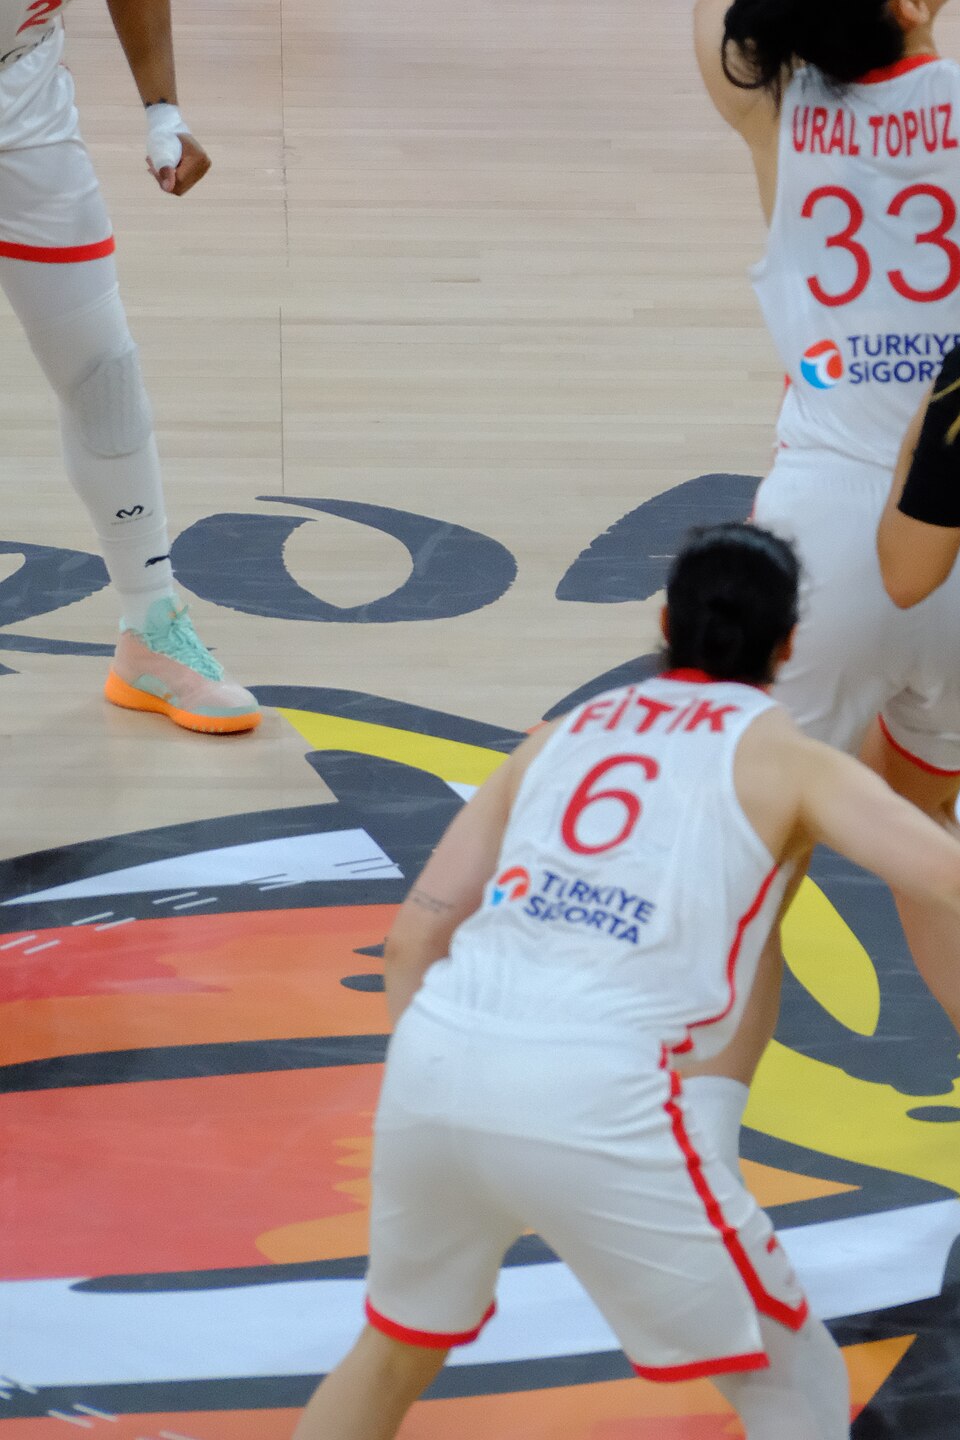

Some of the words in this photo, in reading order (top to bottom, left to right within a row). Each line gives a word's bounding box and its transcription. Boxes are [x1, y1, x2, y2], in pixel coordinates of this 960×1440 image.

[792, 105, 860, 157] URAL
[868, 102, 960, 157] TOPUZ
[849, 359, 944, 385] SİGOR
[561, 753, 660, 856] 6
